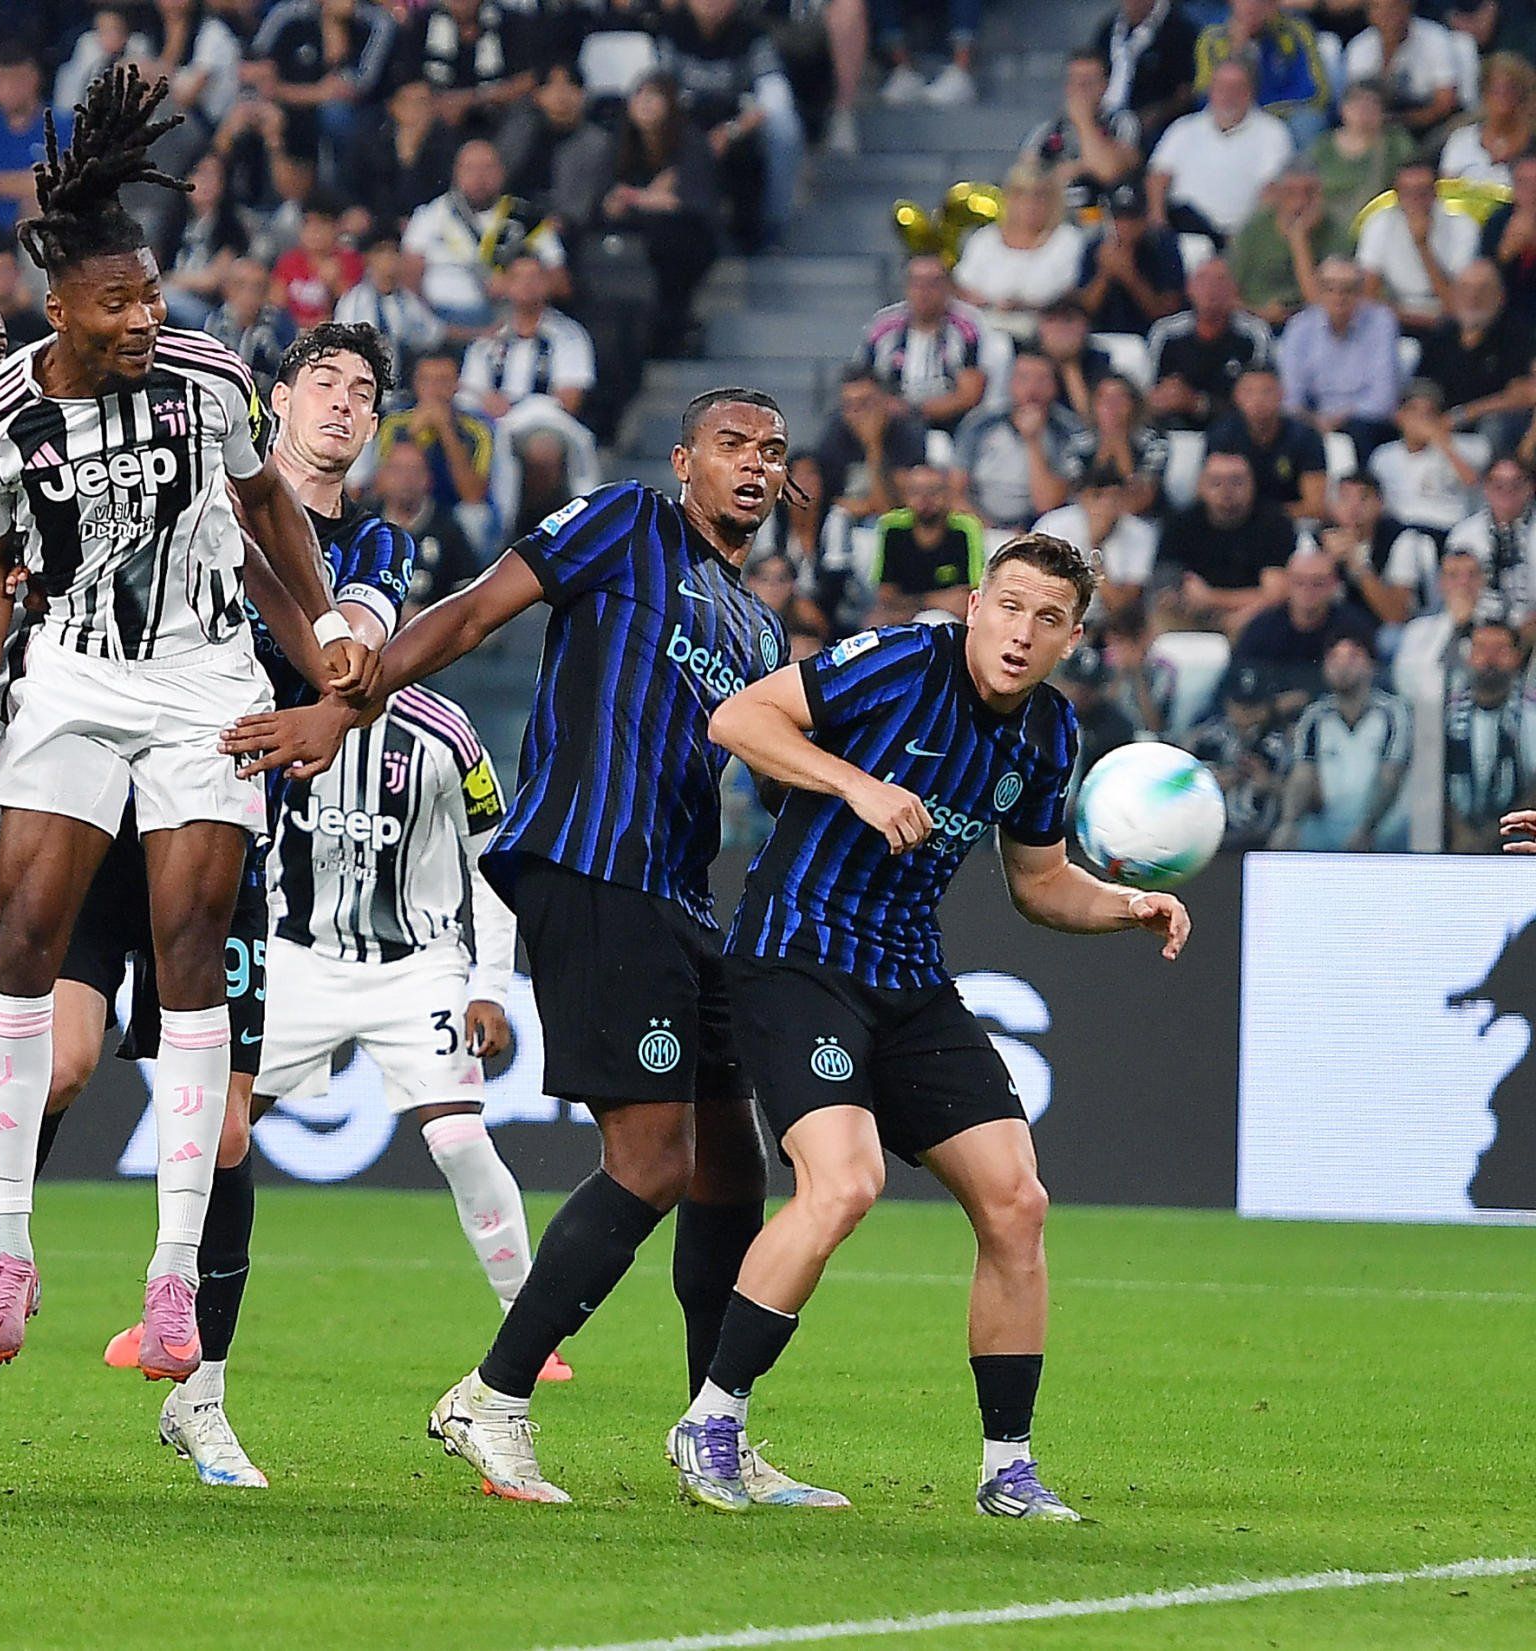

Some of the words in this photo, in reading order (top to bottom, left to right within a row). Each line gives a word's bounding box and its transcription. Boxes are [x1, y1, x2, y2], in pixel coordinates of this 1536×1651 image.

[39, 447, 177, 502] Jeep
[81, 516, 156, 542] Detroit
[94, 501, 140, 520] VISIT
[666, 624, 745, 696] betss
[290, 795, 402, 852] Jeep
[430, 1009, 459, 1056] 3
